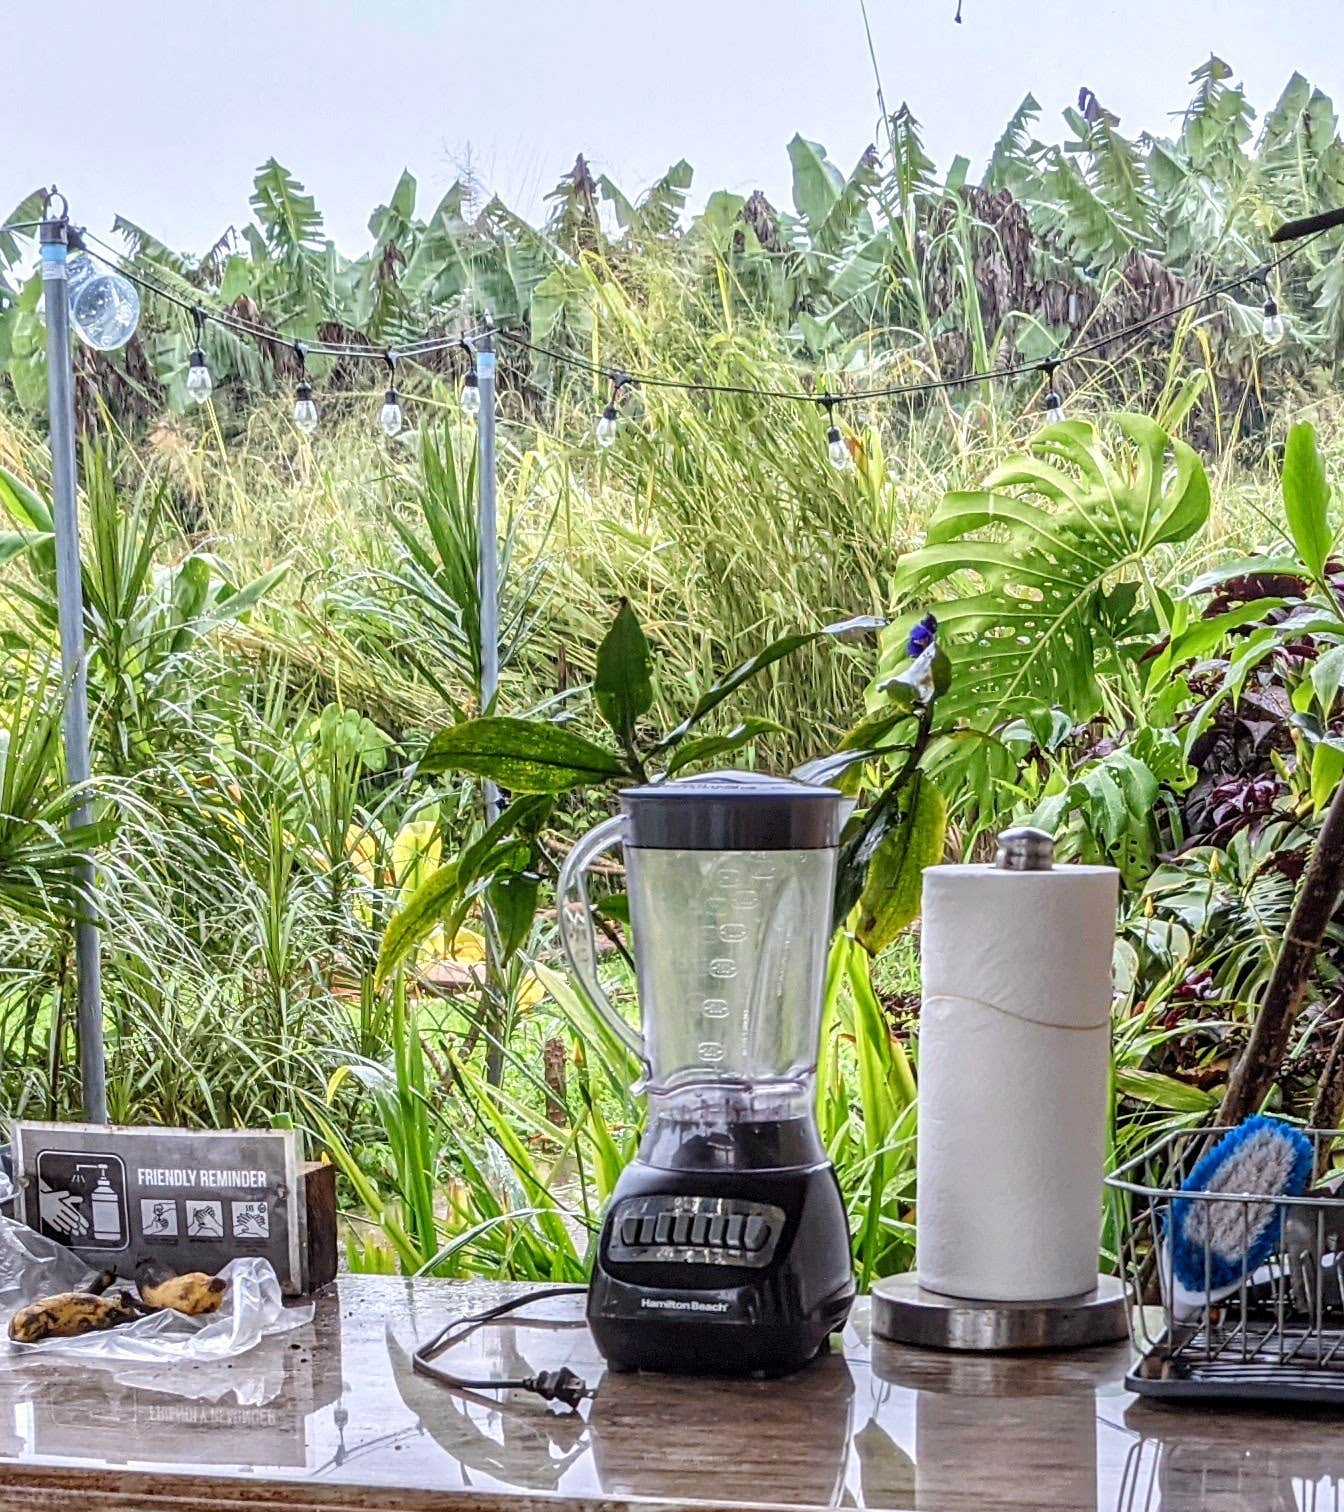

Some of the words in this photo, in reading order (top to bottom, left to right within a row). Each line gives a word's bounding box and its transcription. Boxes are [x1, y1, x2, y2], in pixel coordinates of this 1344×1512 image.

[137, 1168, 197, 1187] FRIENDLY
[200, 1170, 267, 1188] REMINDER
[641, 1298, 690, 1310] Hamilton
[691, 1300, 727, 1312] Beach
